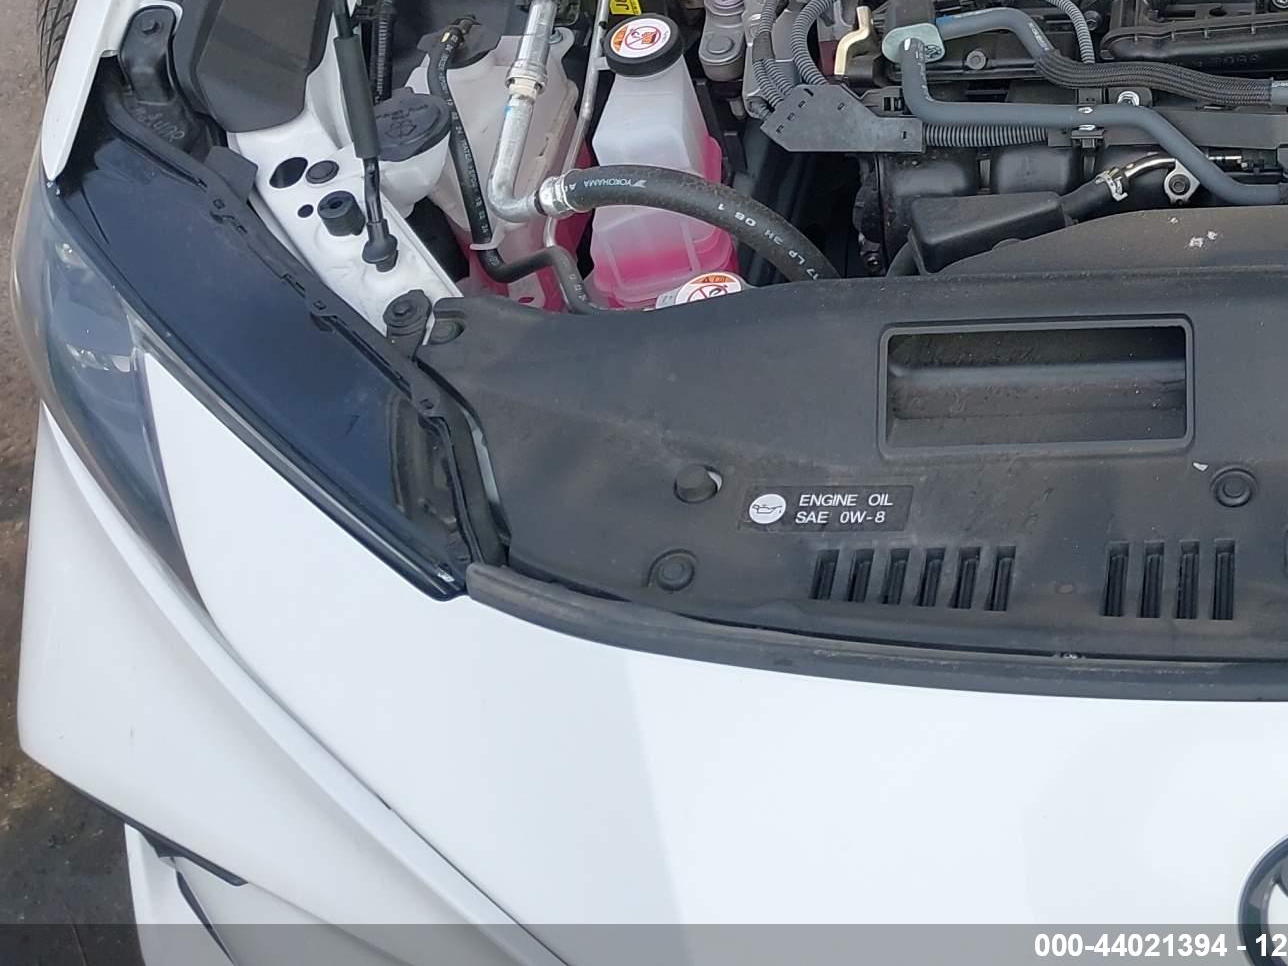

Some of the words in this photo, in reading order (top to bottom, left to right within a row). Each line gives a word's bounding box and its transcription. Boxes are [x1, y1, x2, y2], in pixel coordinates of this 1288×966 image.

[583, 178, 632, 188] YOKOHAMA
[788, 250, 805, 265] LP
[799, 493, 858, 507] ENGINE
[868, 493, 894, 506] OIL
[795, 510, 830, 524] SAE
[840, 510, 886, 524] 0W-8
